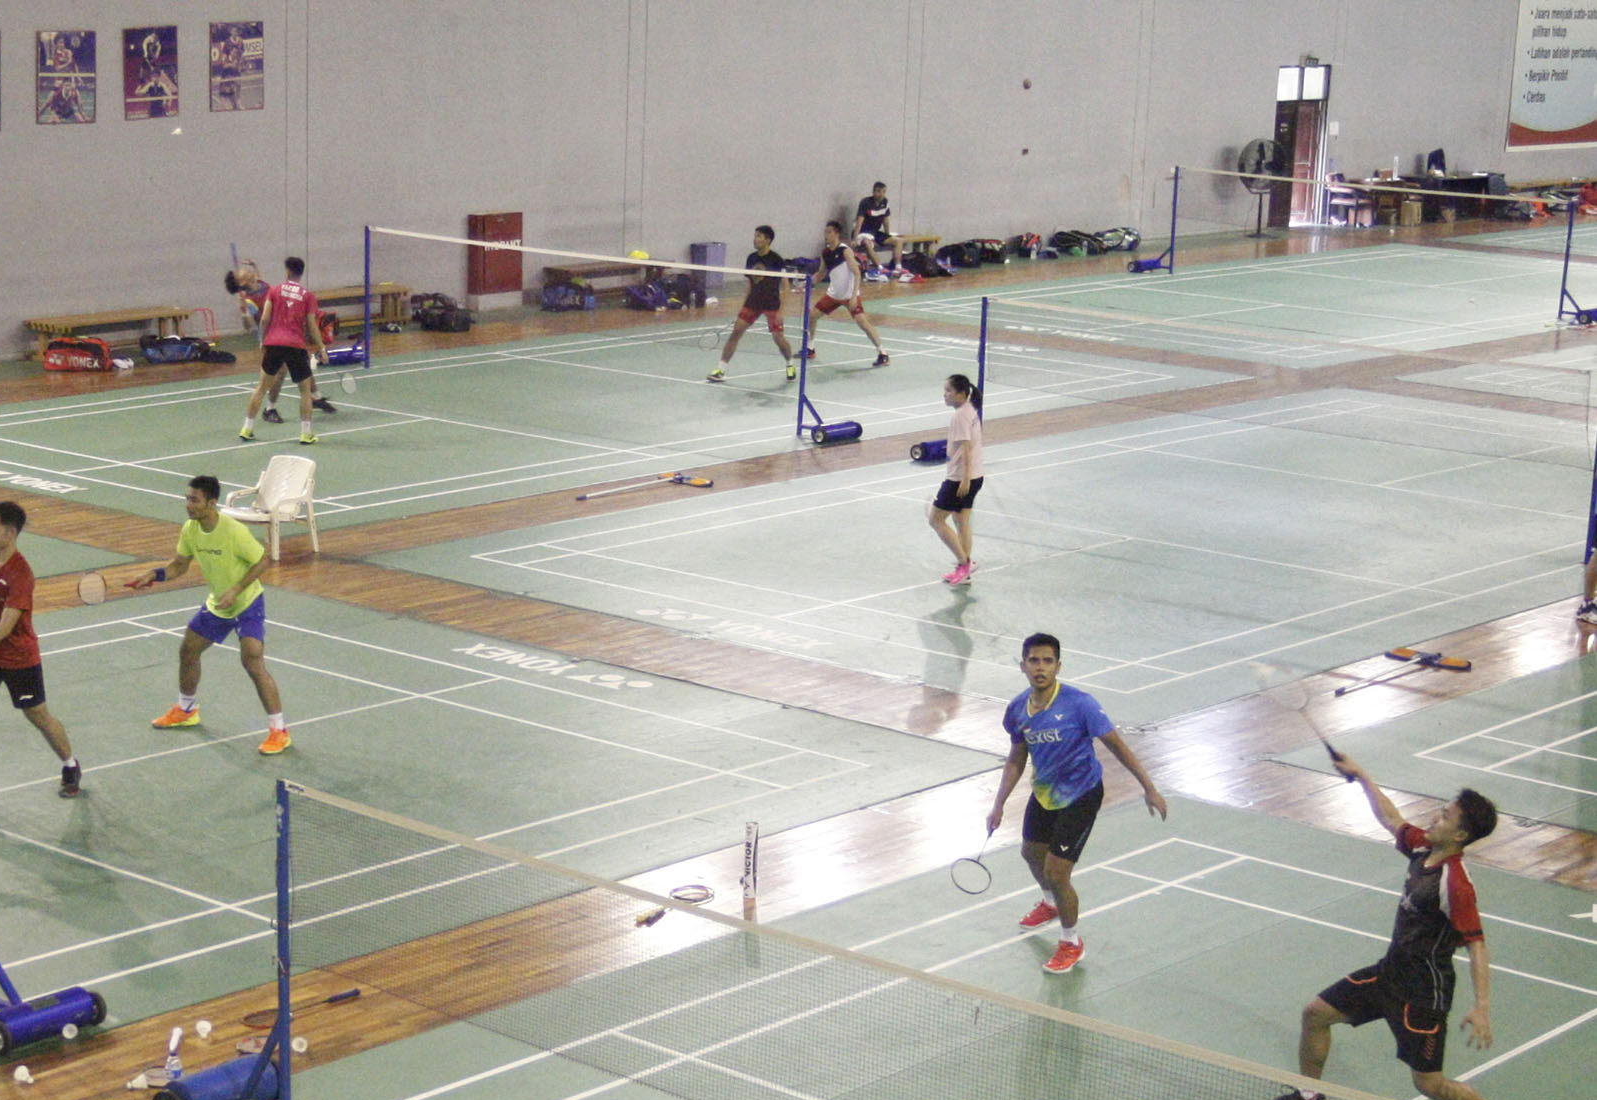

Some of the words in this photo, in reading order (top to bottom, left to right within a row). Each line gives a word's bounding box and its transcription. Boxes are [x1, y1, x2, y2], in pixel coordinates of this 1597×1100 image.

[67, 356, 100, 368] YONEX
[452, 642, 578, 676] YONEX
[744, 841, 752, 878] VICTOR
